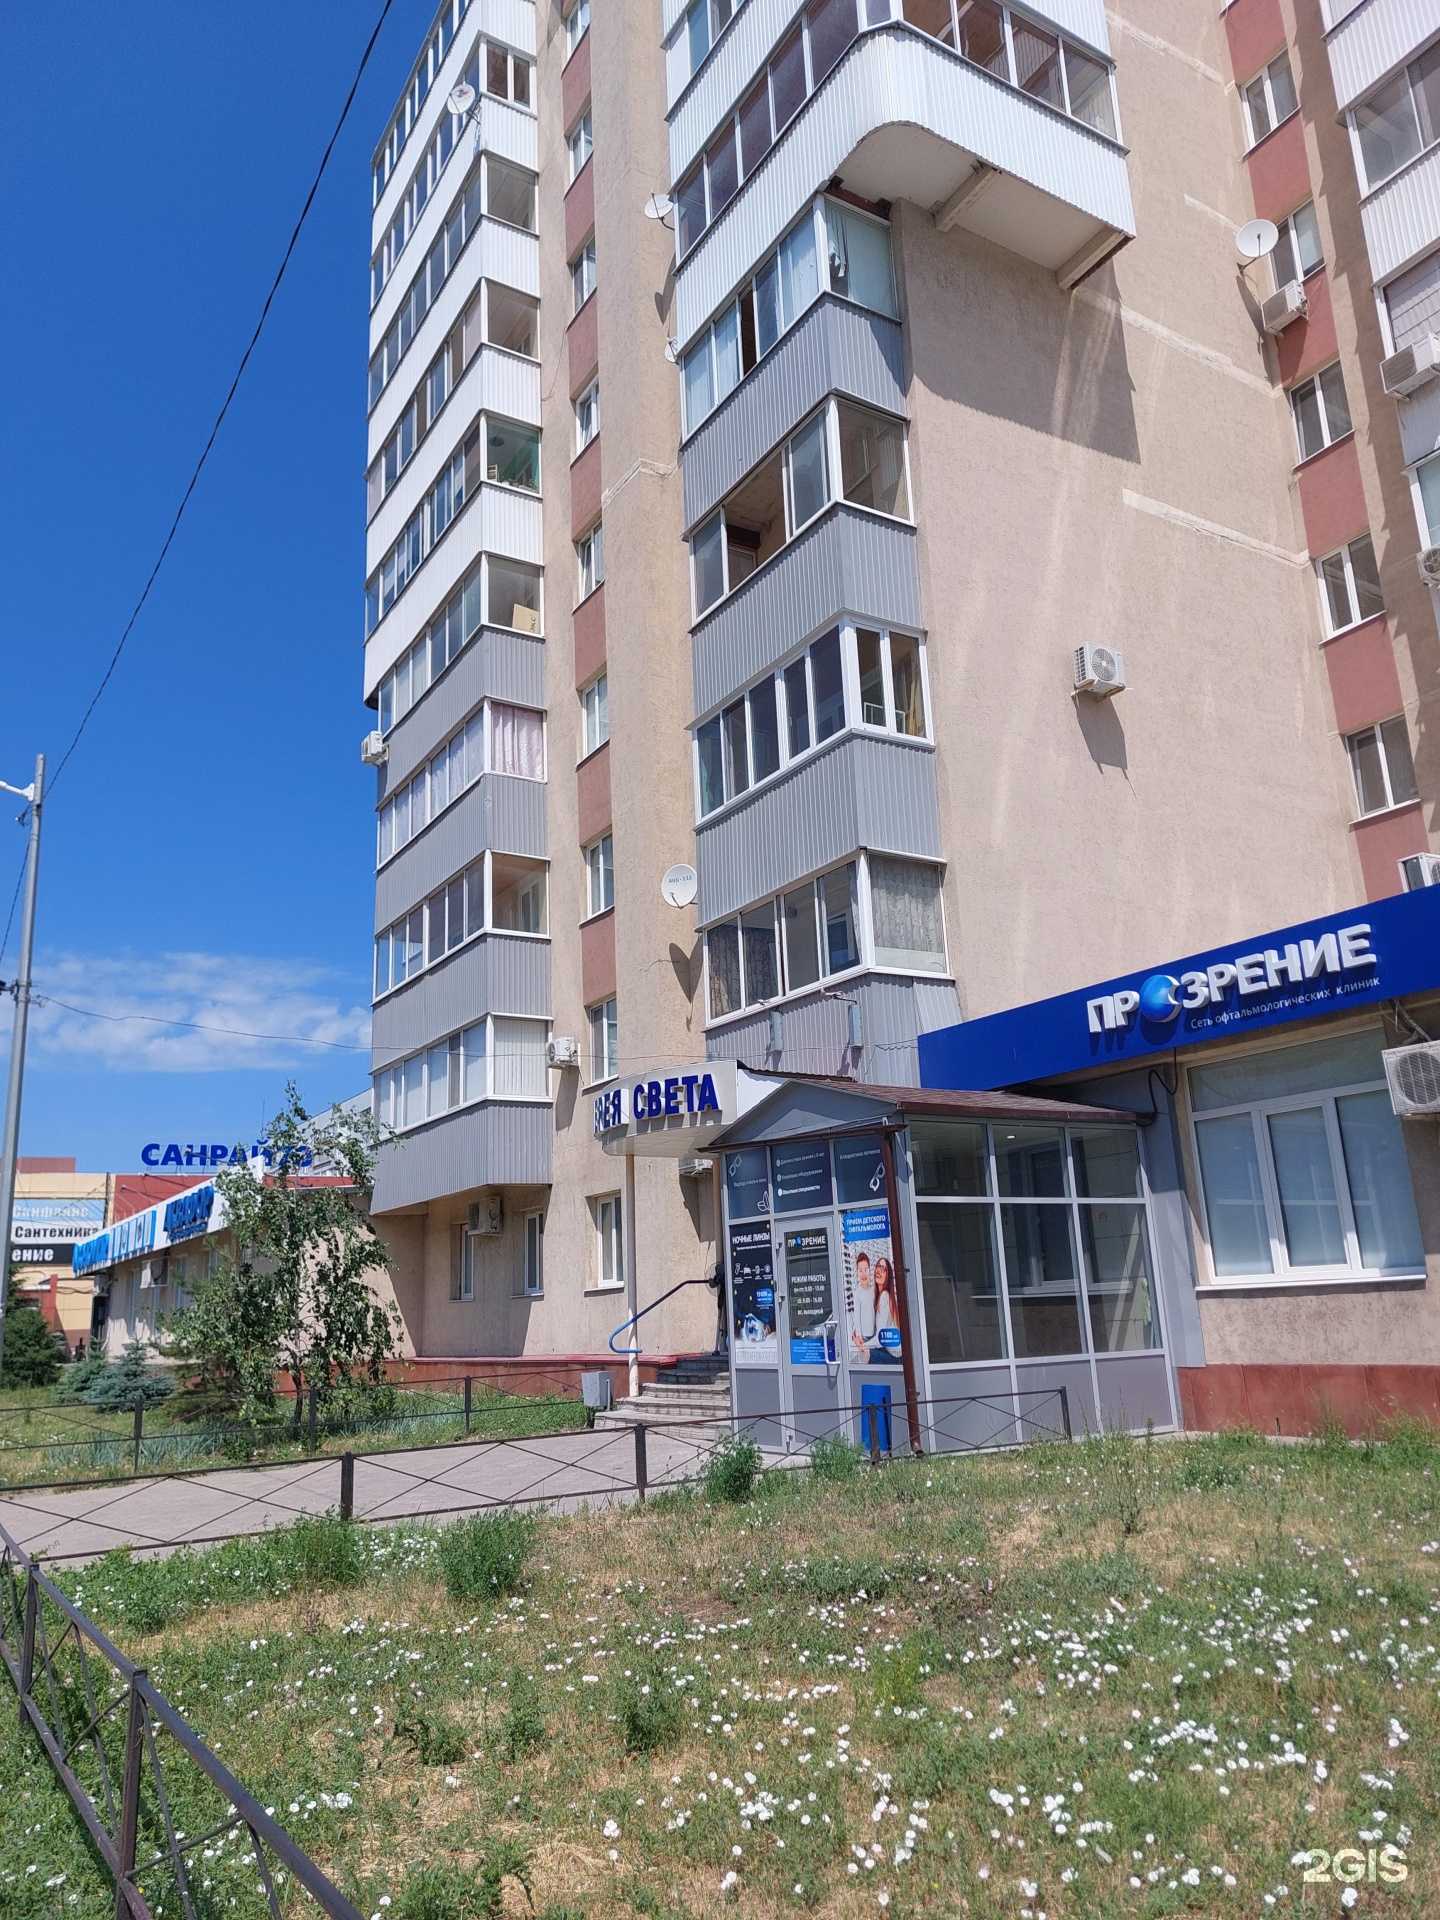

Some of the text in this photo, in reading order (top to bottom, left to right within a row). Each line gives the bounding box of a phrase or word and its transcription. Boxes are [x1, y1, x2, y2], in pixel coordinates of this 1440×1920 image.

[1190, 975, 1381, 1029] Сеть офтальмологических клиник
[633, 1074, 719, 1120] СВЕТА
